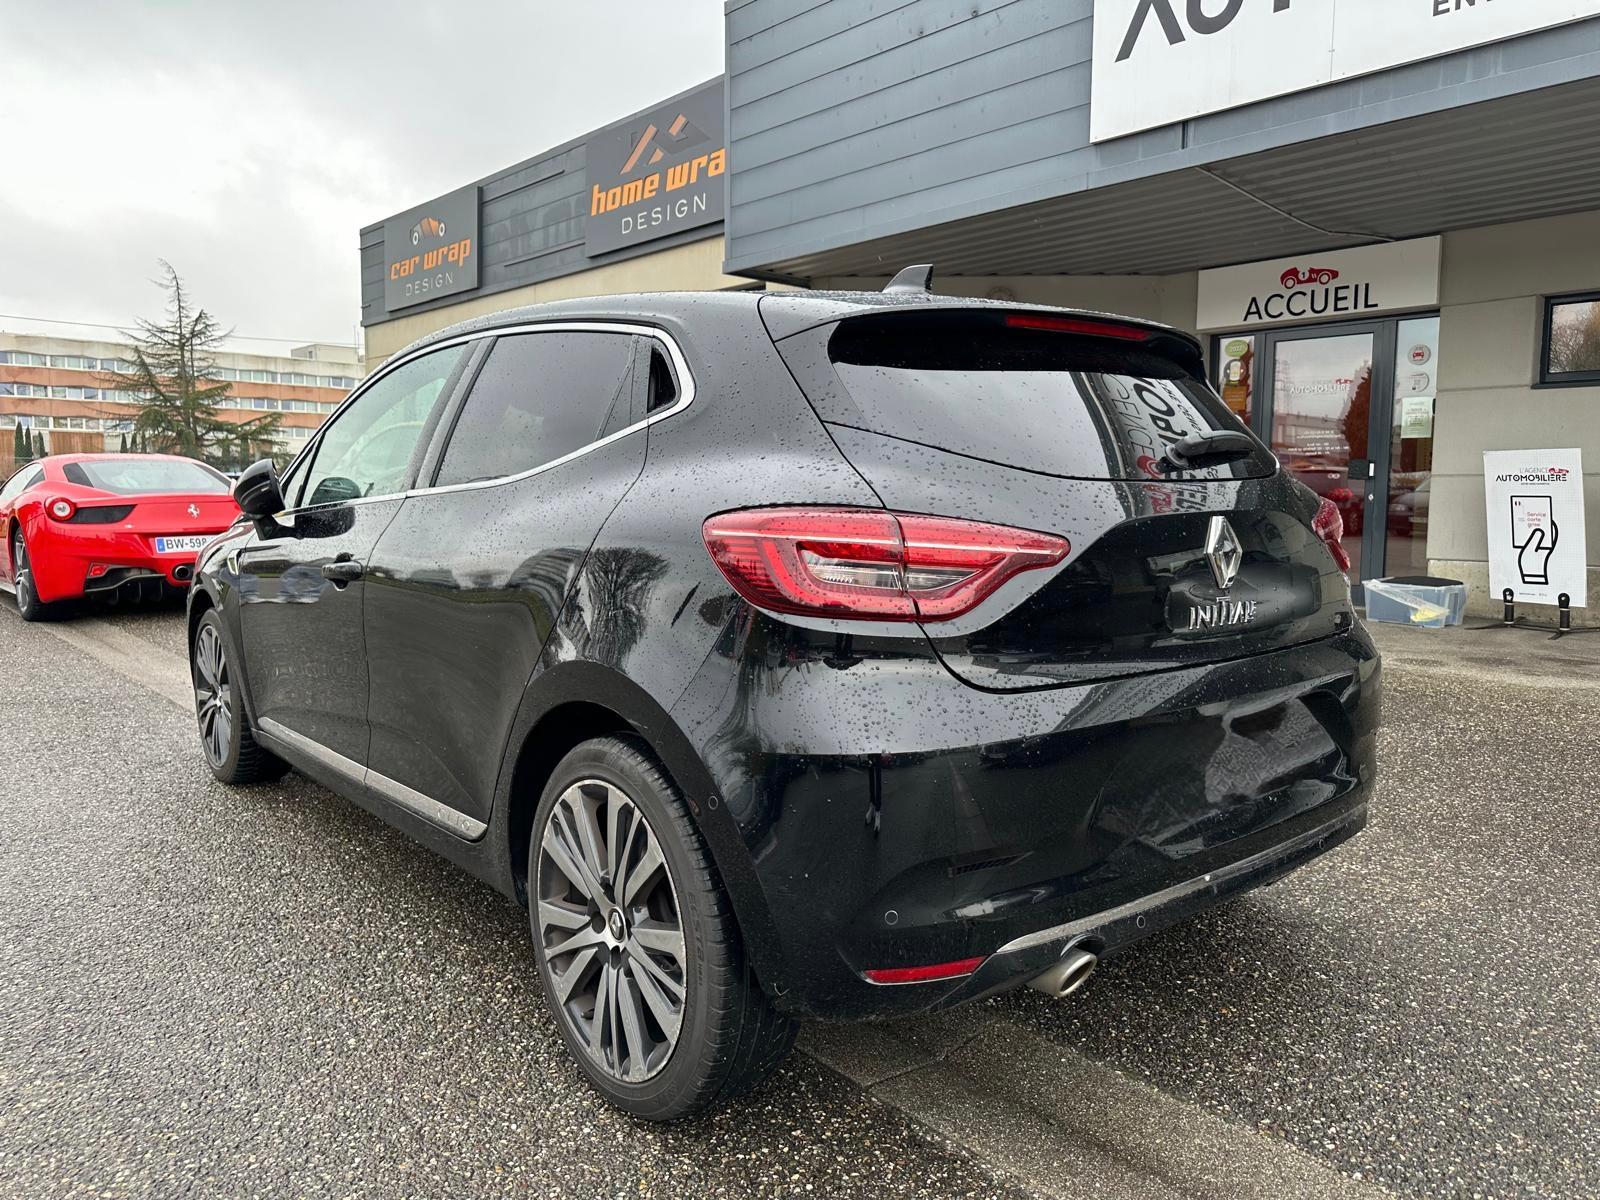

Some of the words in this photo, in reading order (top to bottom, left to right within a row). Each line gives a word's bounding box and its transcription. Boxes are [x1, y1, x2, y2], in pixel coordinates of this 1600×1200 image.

[591, 173, 660, 217] home
[621, 192, 707, 235] DESIGN
[390, 255, 420, 281] car
[423, 239, 471, 268] wrap
[405, 272, 453, 297] DESIGN
[1243, 283, 1379, 321] ACCUEIL
